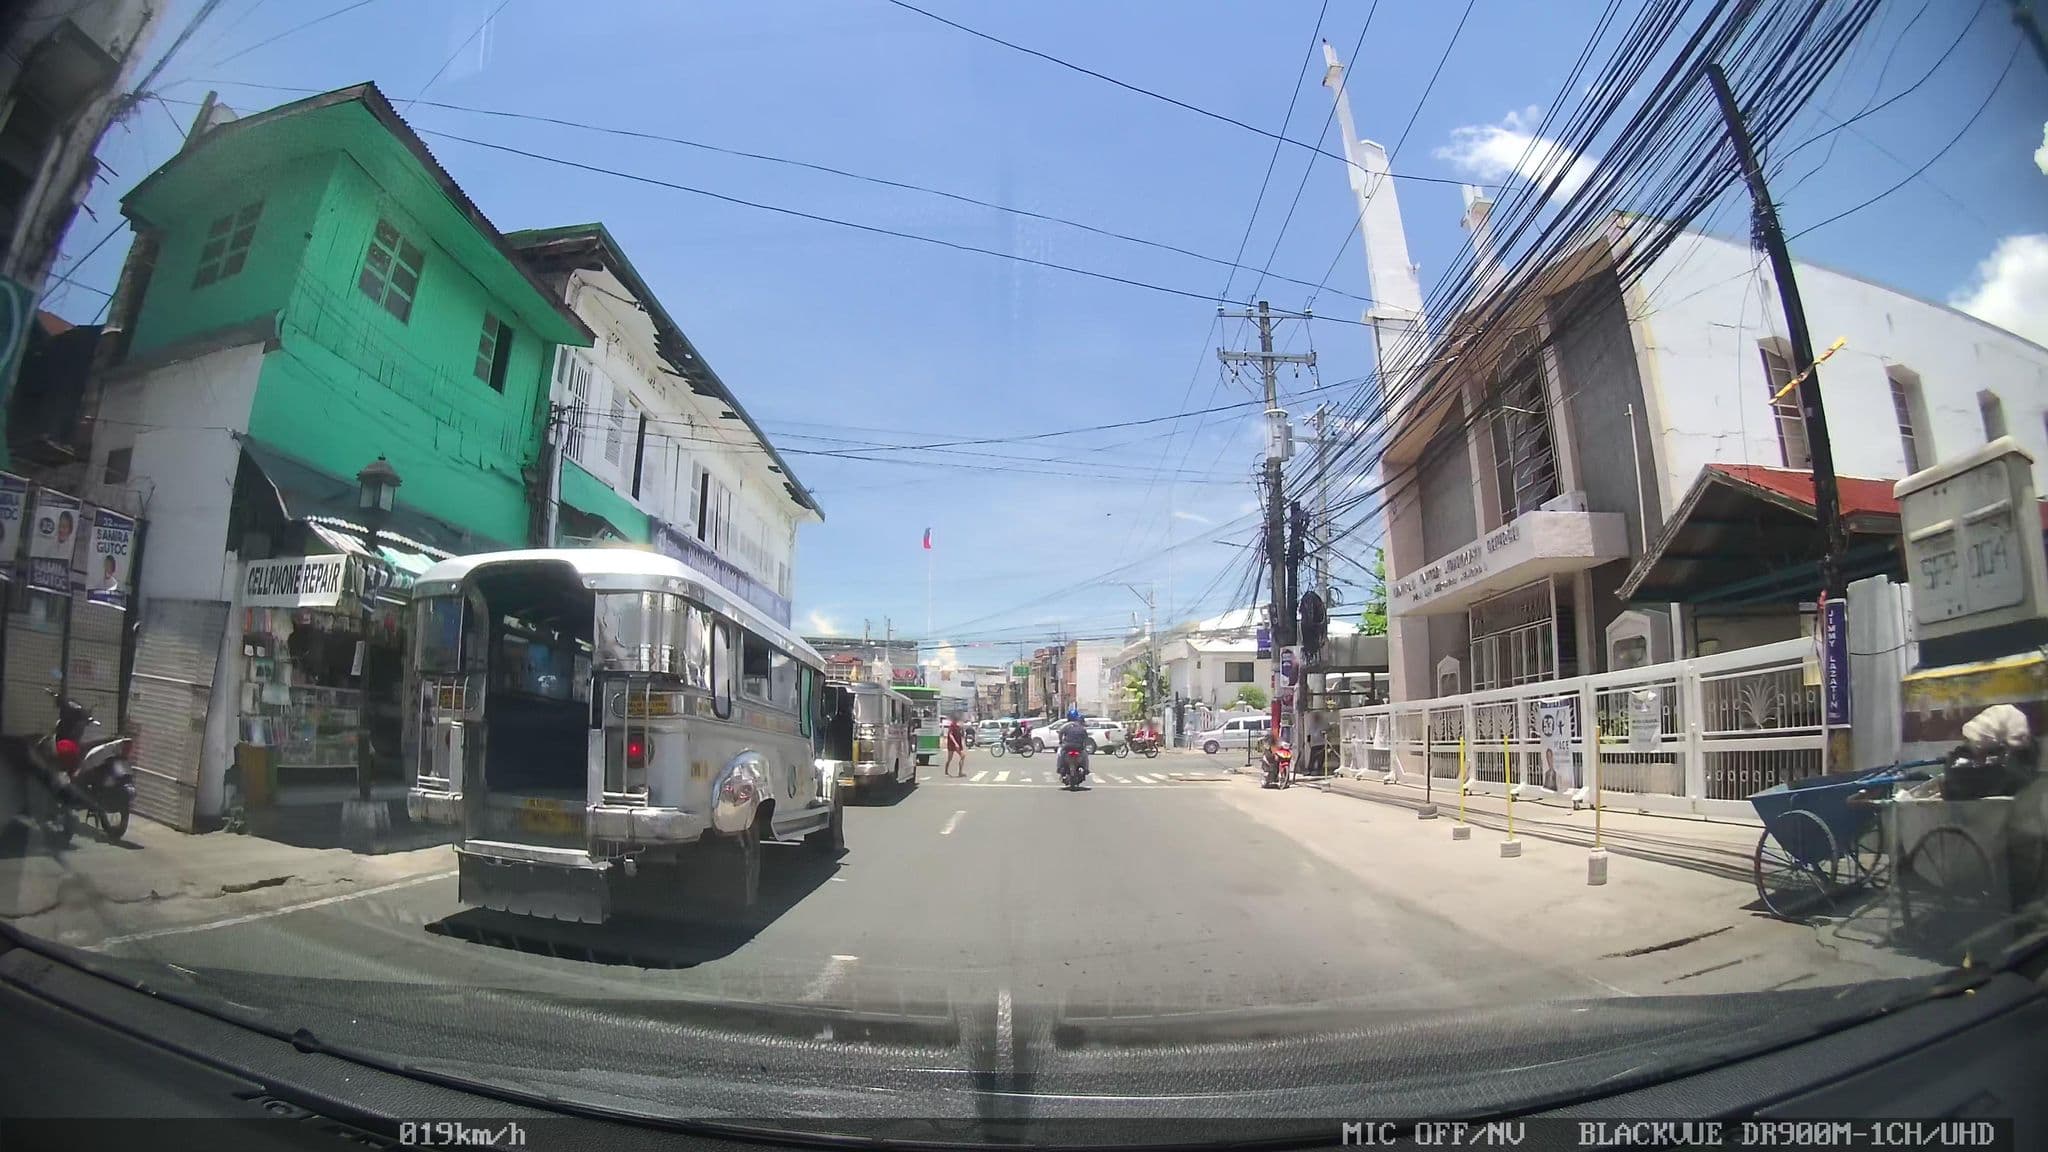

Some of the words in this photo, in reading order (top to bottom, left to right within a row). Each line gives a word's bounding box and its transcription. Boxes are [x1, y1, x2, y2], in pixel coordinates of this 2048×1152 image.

[96, 543, 128, 555] GUTOC
[97, 529, 129, 543] SAMIRA
[248, 565, 302, 595] CELLPHONE
[302, 563, 340, 593] REPAIR
[1828, 609, 1836, 648] JIMMY
[1829, 655, 1838, 708] LAZATIN
